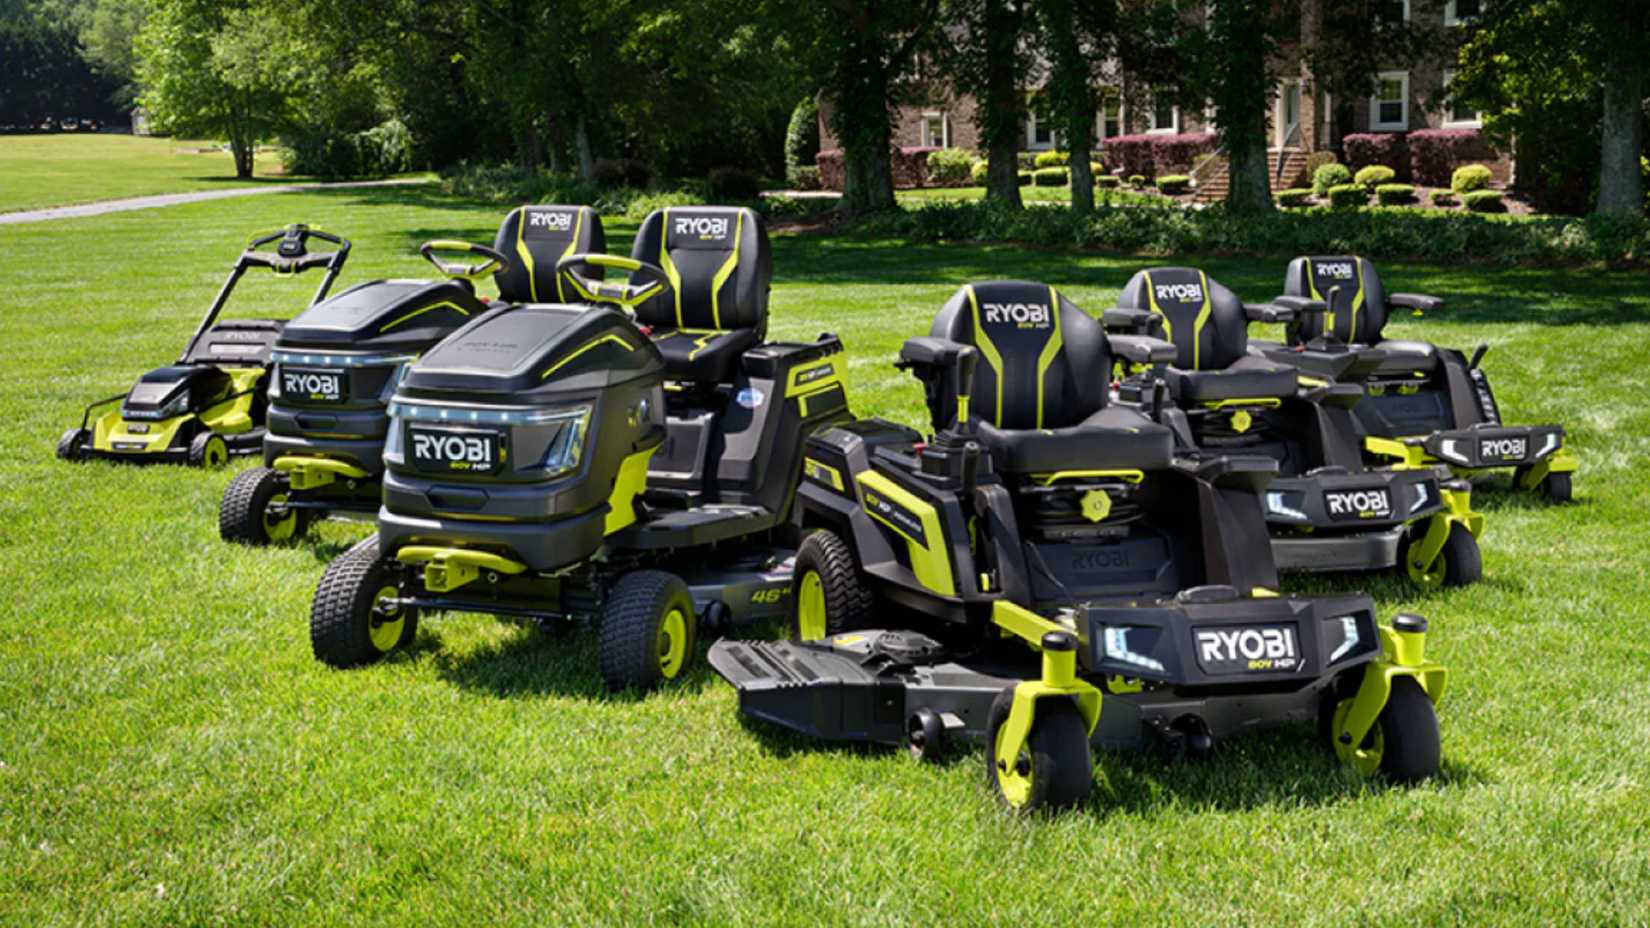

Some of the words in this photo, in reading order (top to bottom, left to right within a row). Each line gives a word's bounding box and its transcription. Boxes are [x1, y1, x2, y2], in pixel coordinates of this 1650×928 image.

[530, 212, 573, 226] RYOBI
[675, 218, 728, 235] RYOBI
[1316, 263, 1352, 276] RYOBI
[1156, 284, 1201, 299] RYOBI
[983, 303, 1050, 323] RYOBI
[284, 374, 339, 394] RYOBI
[413, 434, 492, 462] RYOBI
[1481, 439, 1526, 456] RYOBI
[449, 462, 471, 470] 80V
[471, 462, 491, 471] HP
[1326, 490, 1389, 513] RYOBI
[1071, 550, 1130, 569] RYOBI
[1198, 628, 1295, 661] RYOBI
[1248, 660, 1273, 670] 80V
[1274, 659, 1296, 669] HP
